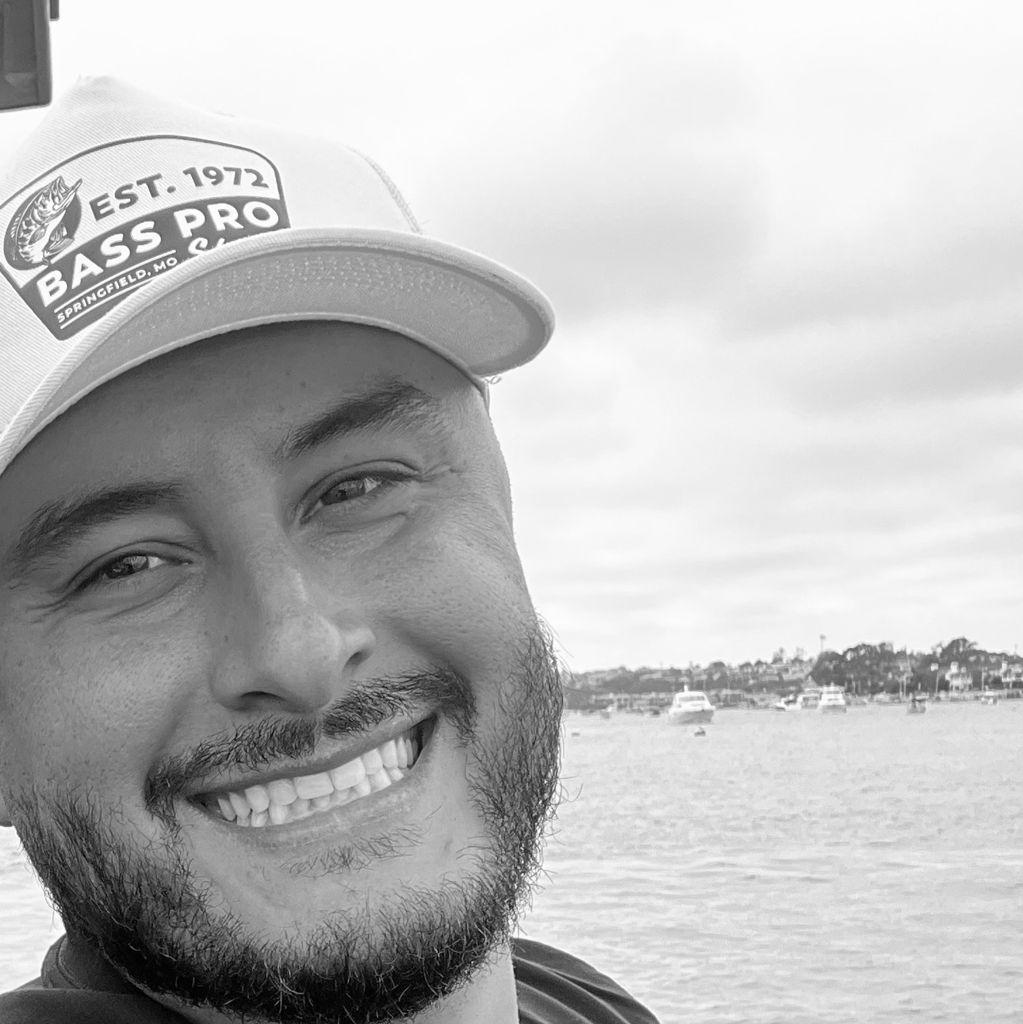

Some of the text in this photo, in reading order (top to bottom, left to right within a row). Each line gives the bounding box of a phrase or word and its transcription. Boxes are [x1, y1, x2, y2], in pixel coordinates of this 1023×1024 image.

[89, 166, 269, 221] EST. 1972
[37, 201, 280, 307] BASS PRO
[58, 256, 178, 323] SPRINGFIELD, MO
